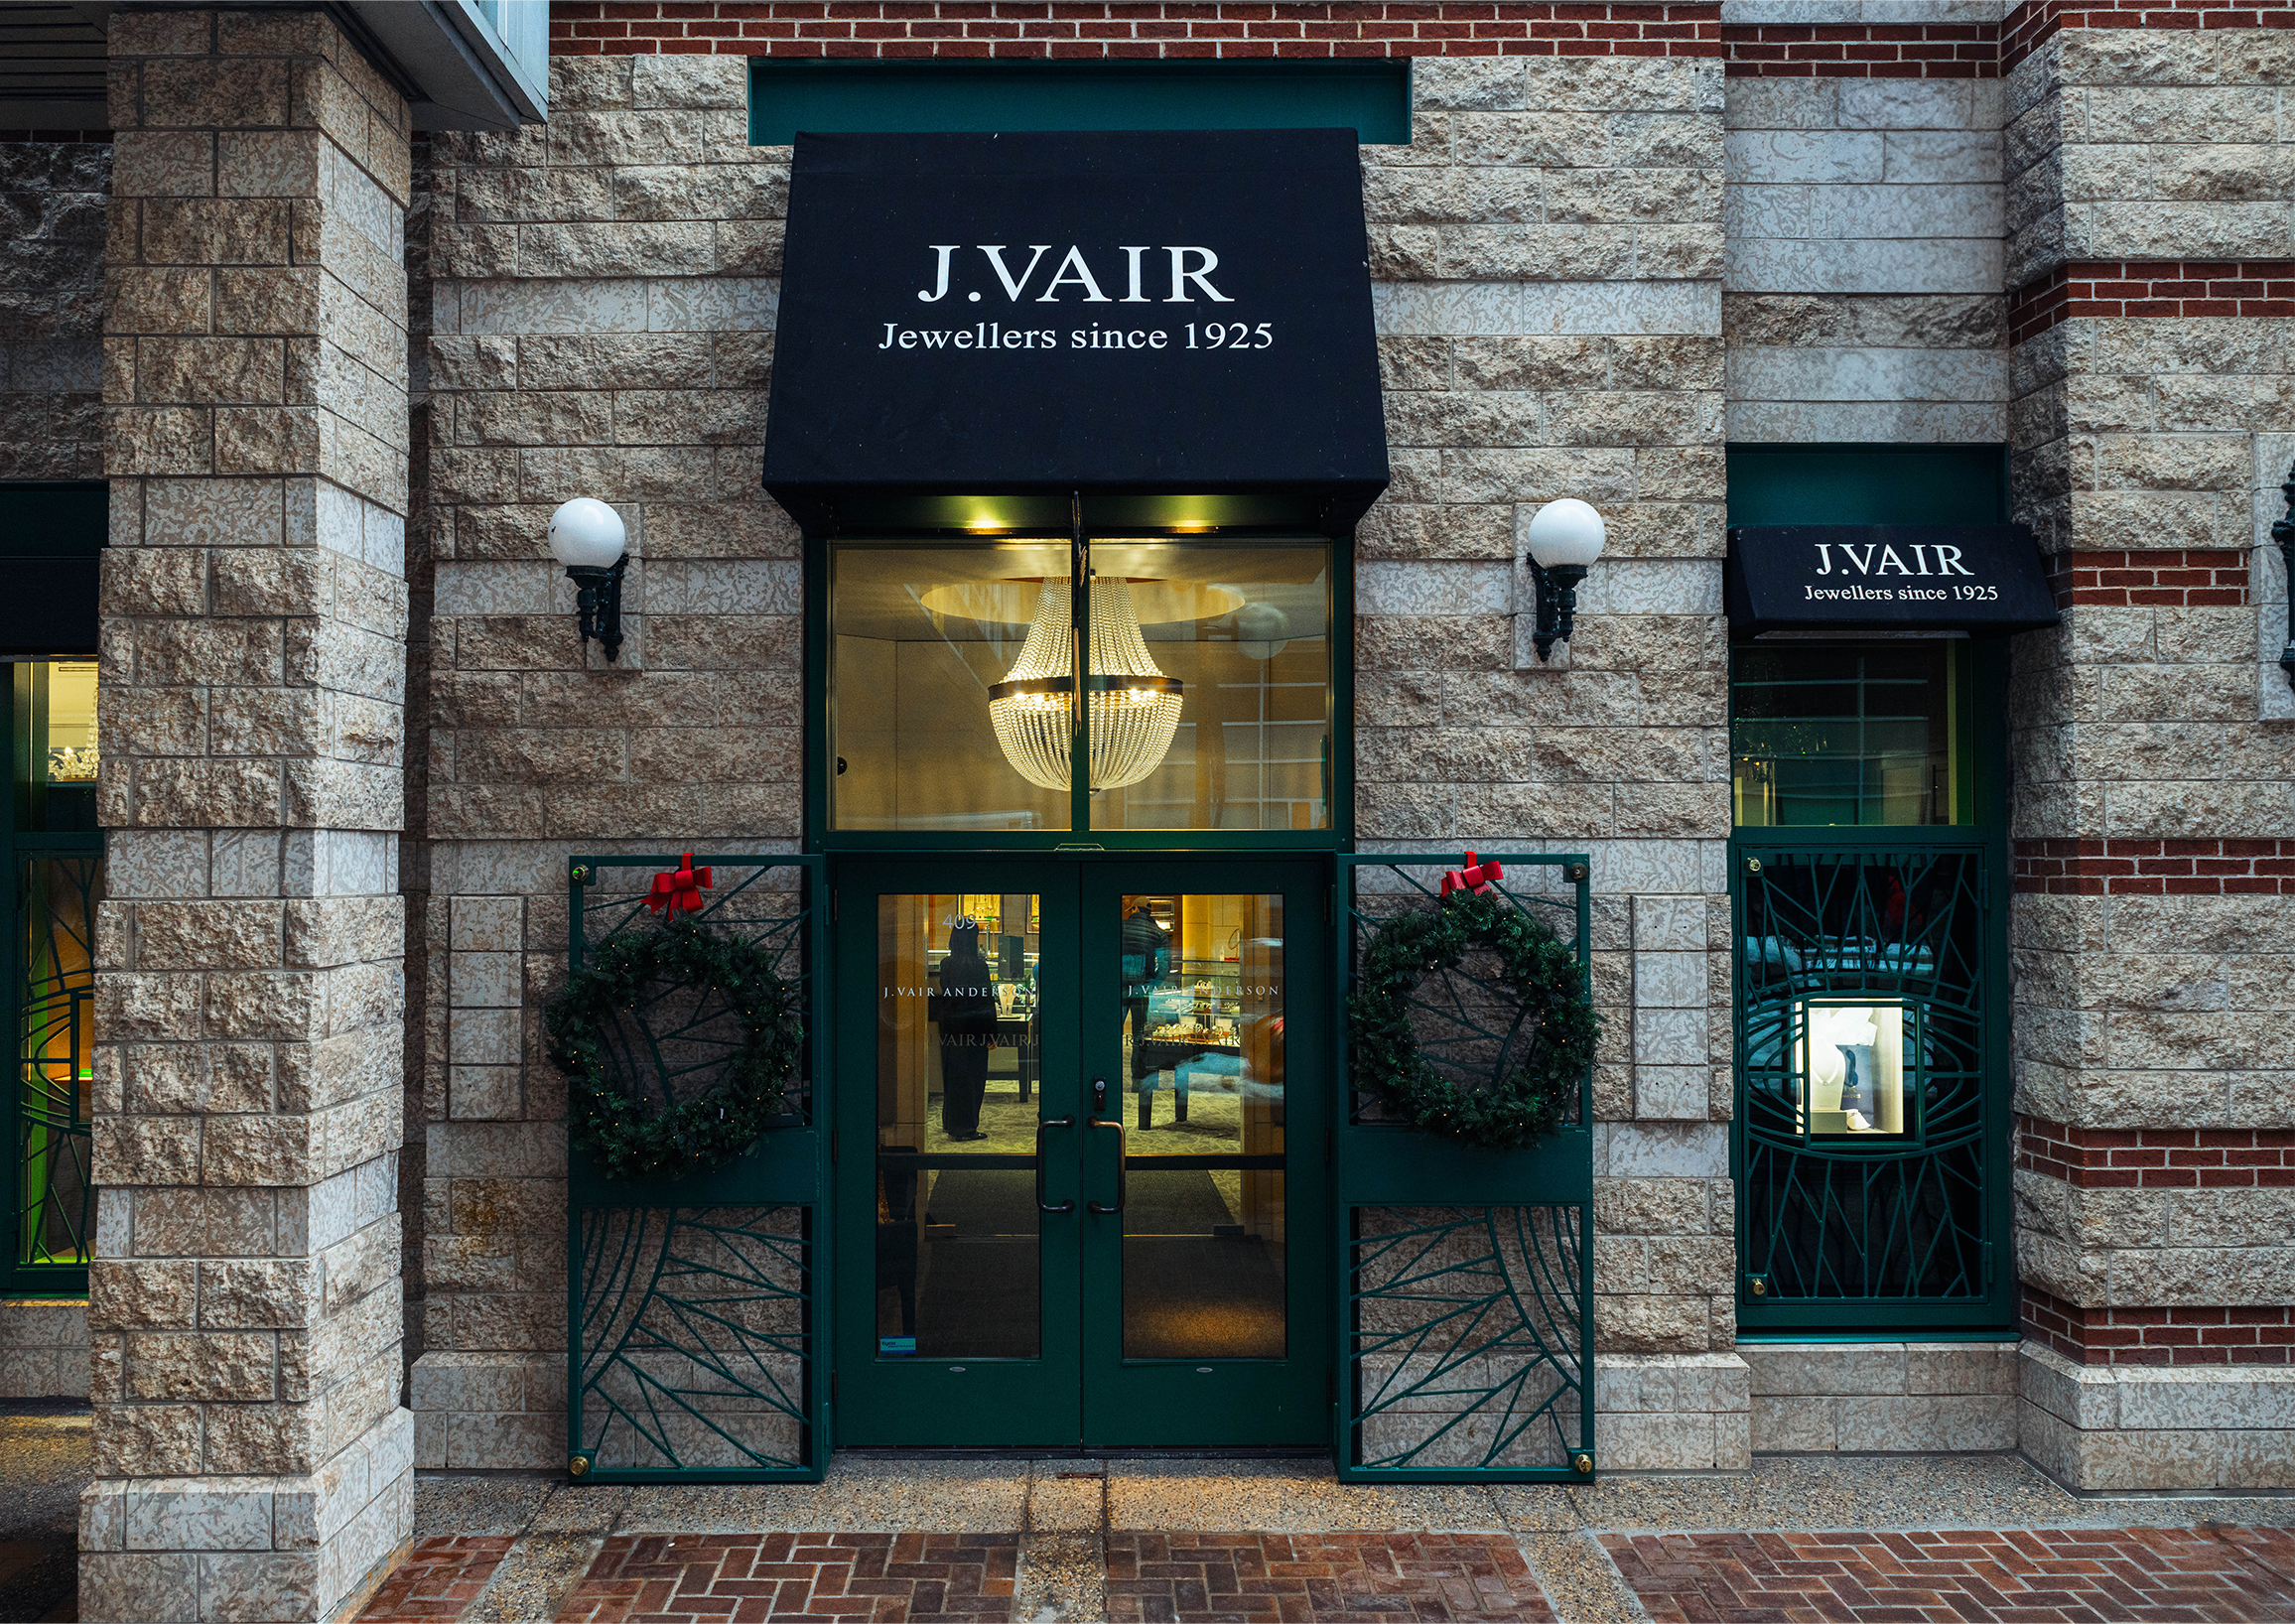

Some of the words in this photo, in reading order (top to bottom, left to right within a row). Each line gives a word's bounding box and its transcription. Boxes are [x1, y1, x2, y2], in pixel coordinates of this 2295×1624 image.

[917, 244, 1236, 303] J.VAIR
[878, 322, 1057, 349] Jewellers
[1071, 322, 1168, 349] since
[1184, 322, 1274, 349] 1925
[1814, 543, 1975, 576] J.VAIR
[1804, 585, 1894, 601] Jewellers
[1897, 585, 1948, 601] since
[1952, 585, 1998, 601] 1925
[942, 913, 977, 930] 409
[943, 987, 1034, 997] ANDERSON
[1187, 985, 1280, 996] ANDERSON
